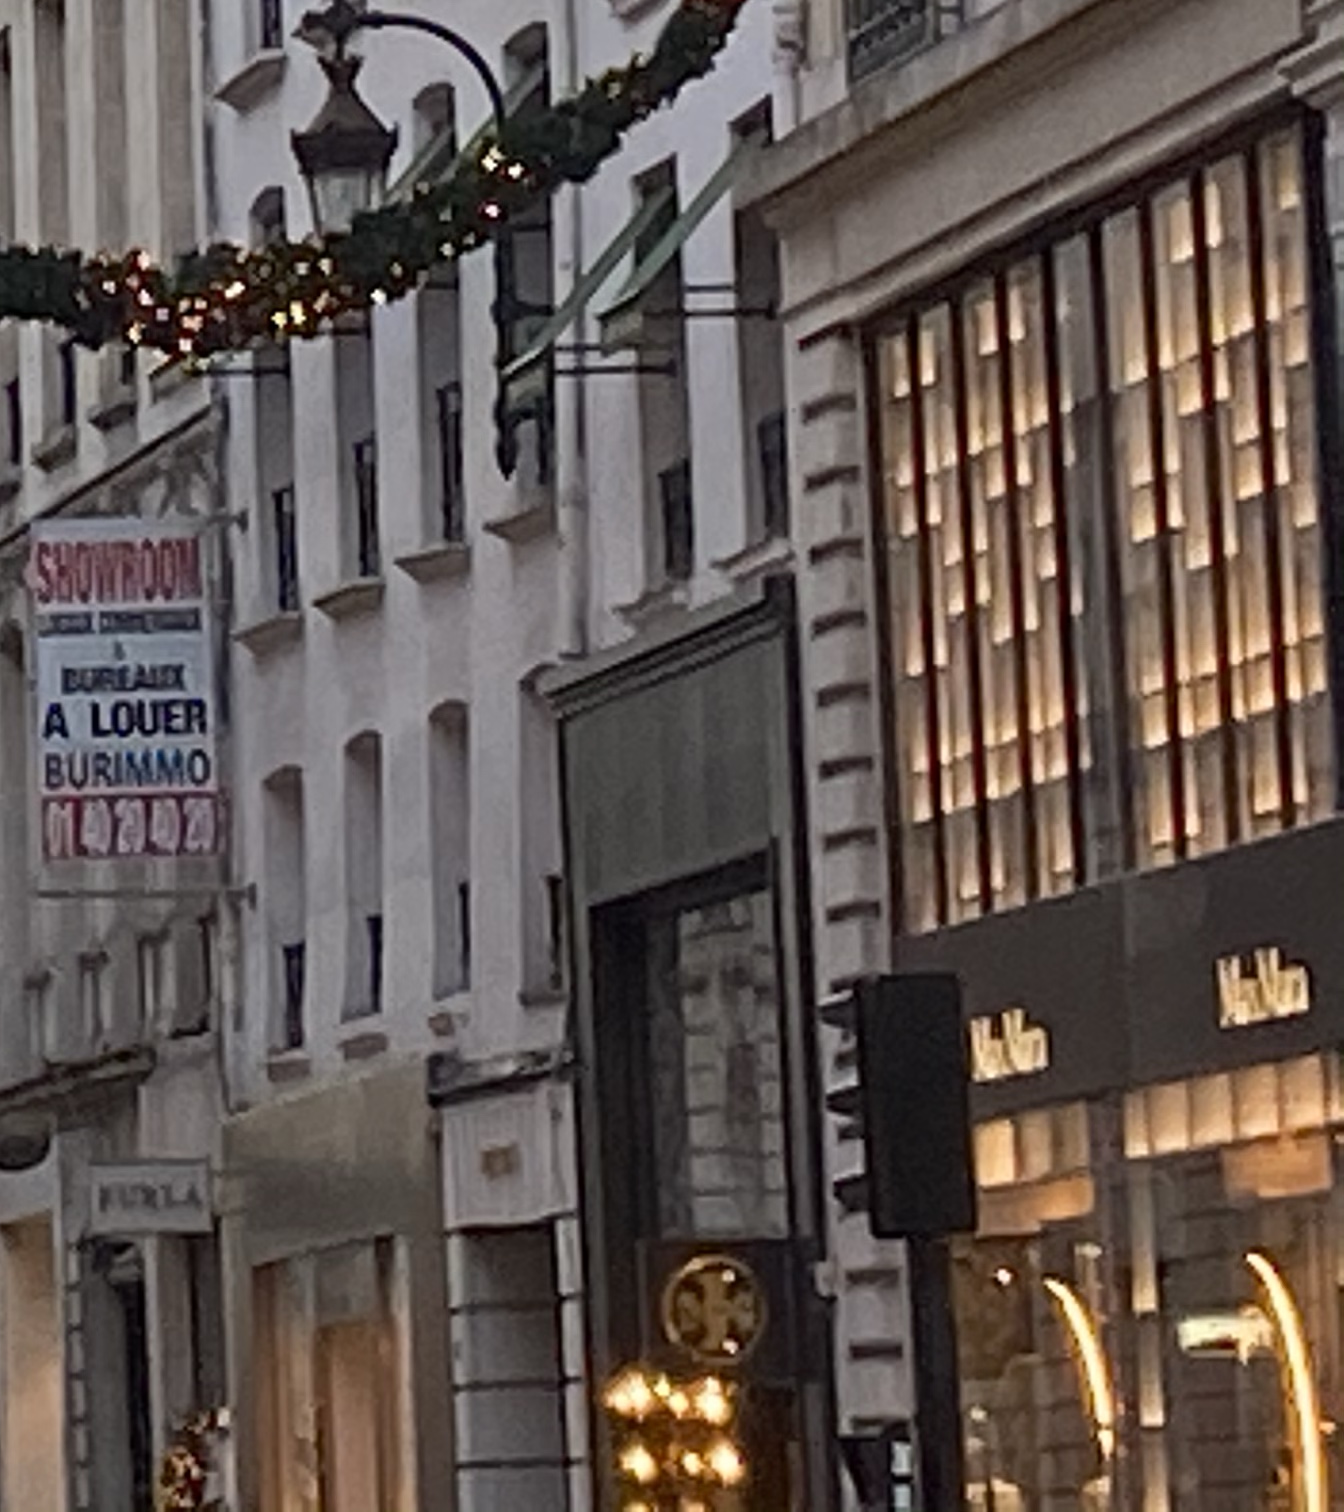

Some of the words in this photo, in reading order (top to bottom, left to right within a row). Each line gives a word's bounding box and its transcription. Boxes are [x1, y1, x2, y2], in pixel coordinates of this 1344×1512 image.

[38, 537, 202, 603] SHOWROOM
[62, 664, 186, 695] BUREAUX
[90, 698, 208, 737] LOUER
[45, 748, 210, 789] BURIMMO
